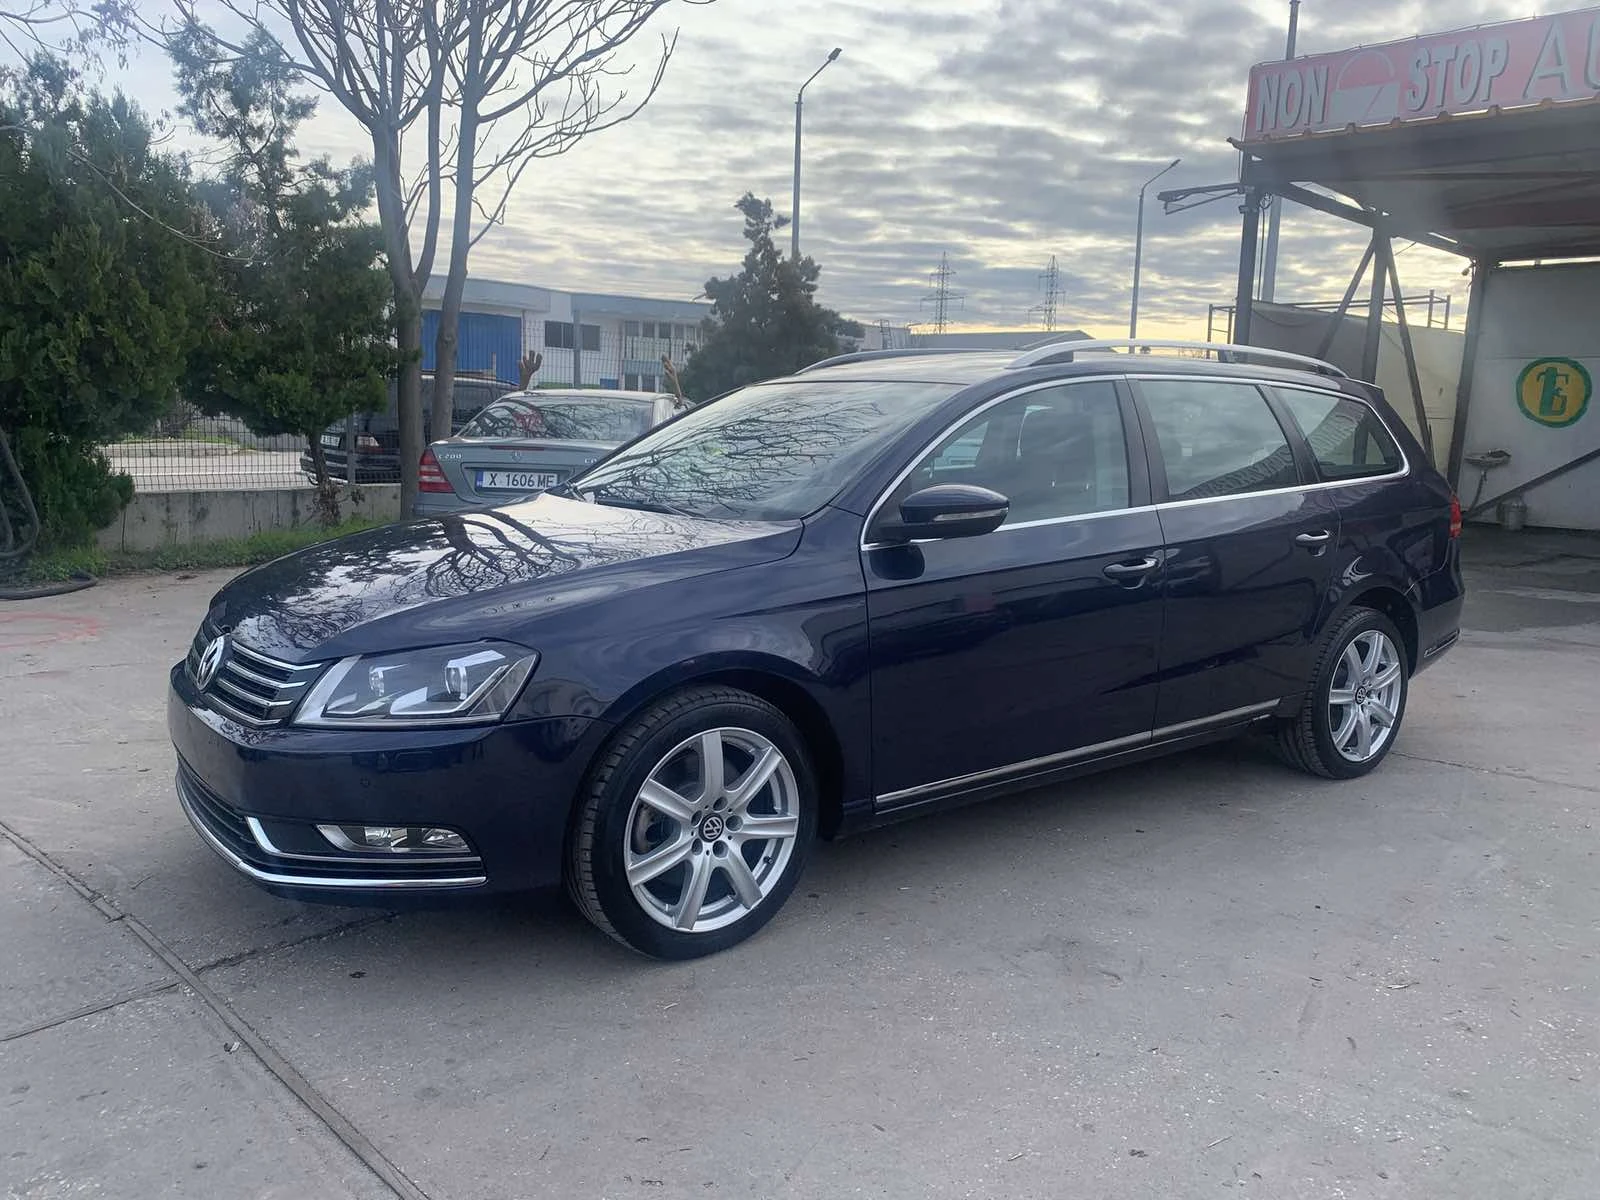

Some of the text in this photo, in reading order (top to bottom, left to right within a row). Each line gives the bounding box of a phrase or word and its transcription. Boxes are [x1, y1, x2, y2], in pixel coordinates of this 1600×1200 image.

[1256, 66, 1329, 133] NON
[1406, 38, 1509, 112] STOP
[489, 473, 497, 486] X
[506, 474, 535, 487] 1606
[537, 474, 554, 488] ME
